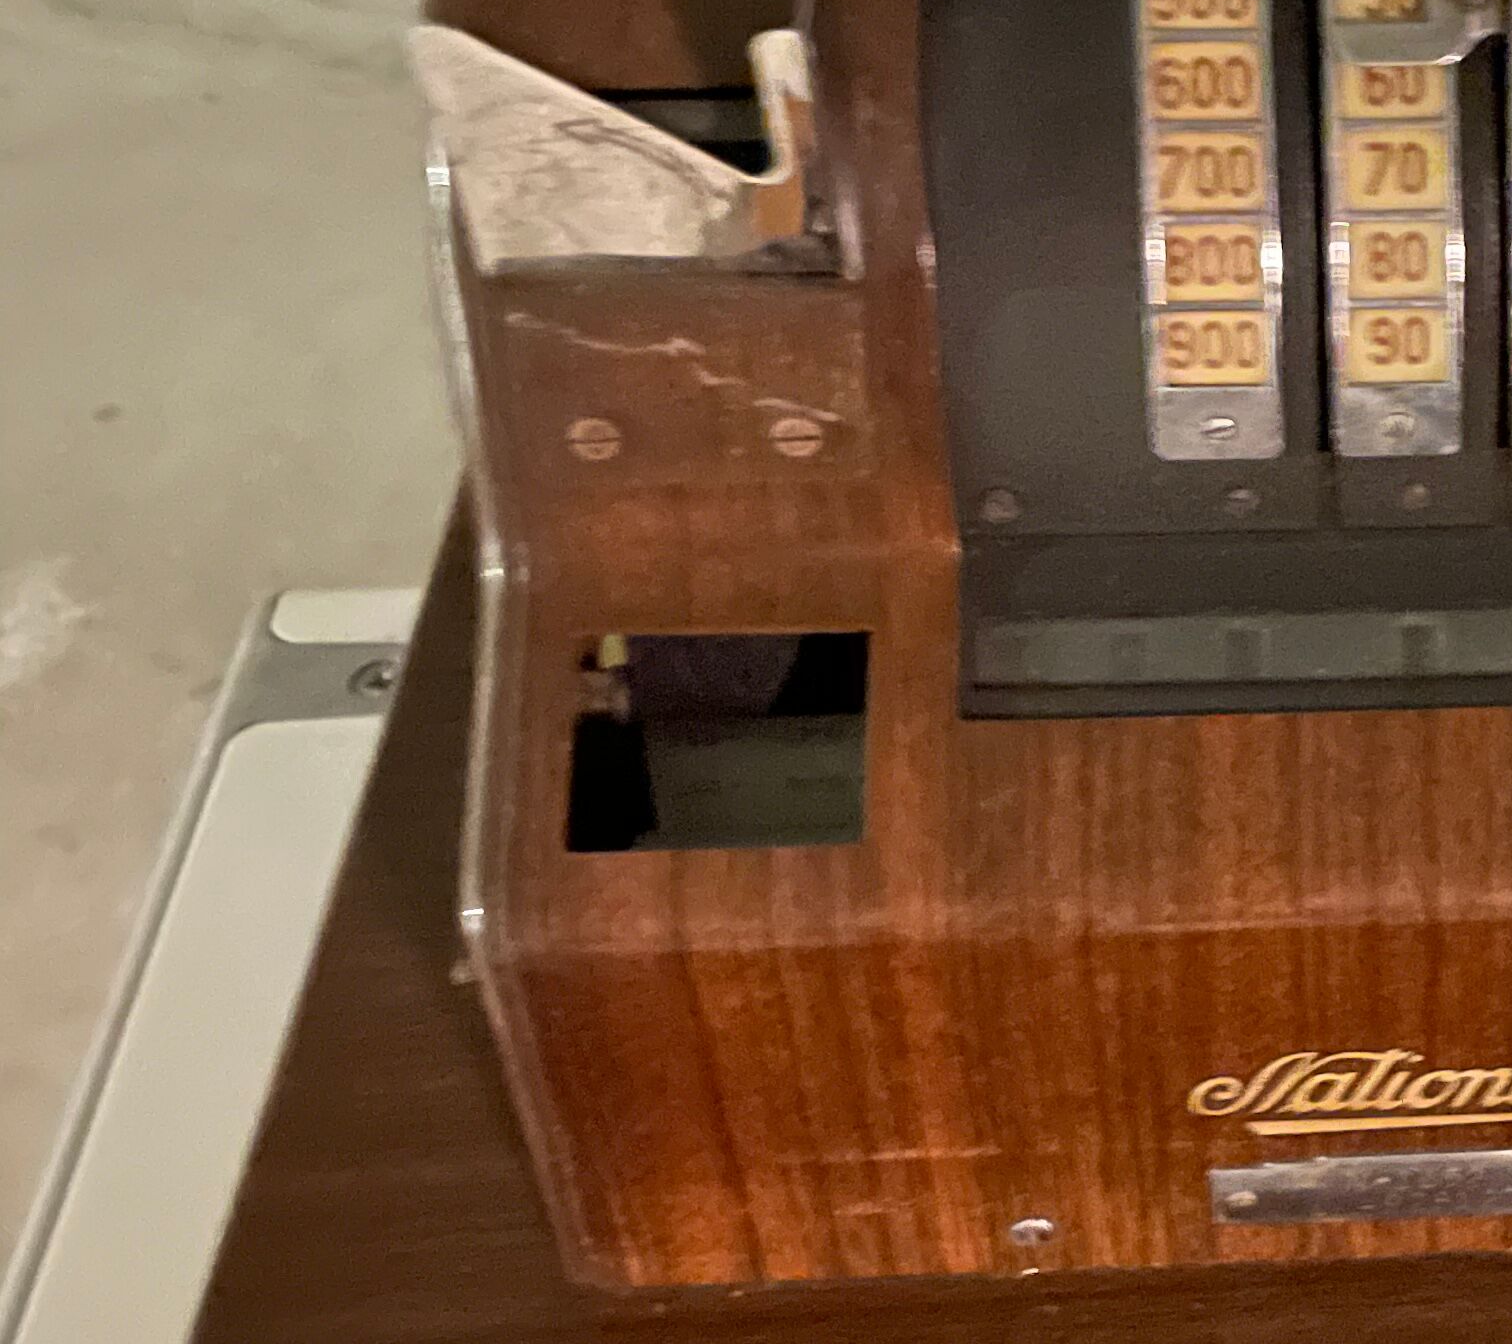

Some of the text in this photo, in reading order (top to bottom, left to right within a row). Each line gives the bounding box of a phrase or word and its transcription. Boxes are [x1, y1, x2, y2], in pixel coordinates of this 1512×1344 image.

[1152, 57, 1252, 109] 600
[1158, 145, 1256, 199] 700
[1362, 142, 1429, 196] 70
[1166, 235, 1258, 286] 800
[1367, 231, 1429, 282] 80
[1366, 316, 1432, 365] 90
